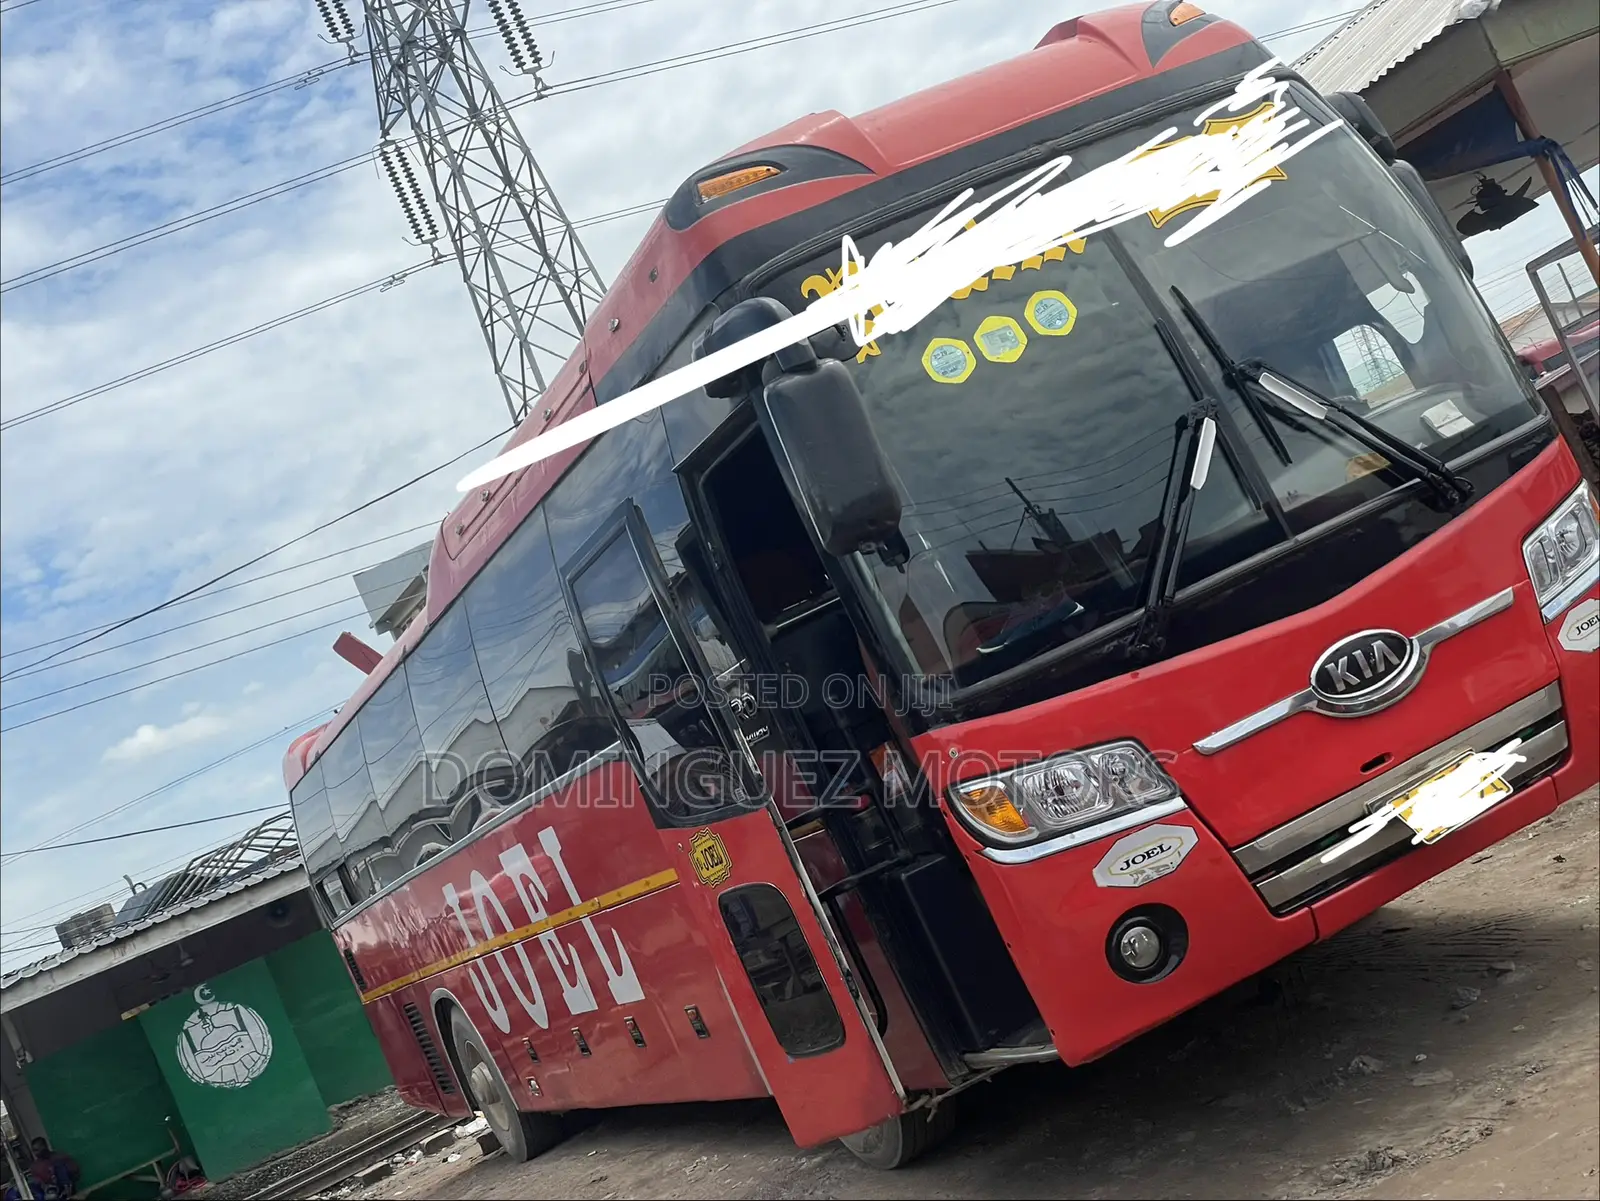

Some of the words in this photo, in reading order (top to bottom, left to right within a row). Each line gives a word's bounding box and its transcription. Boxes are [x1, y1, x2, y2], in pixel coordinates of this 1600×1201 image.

[1325, 639, 1401, 693] KIA
[1119, 843, 1172, 872] JOEL
[441, 826, 646, 1034] JOEL
